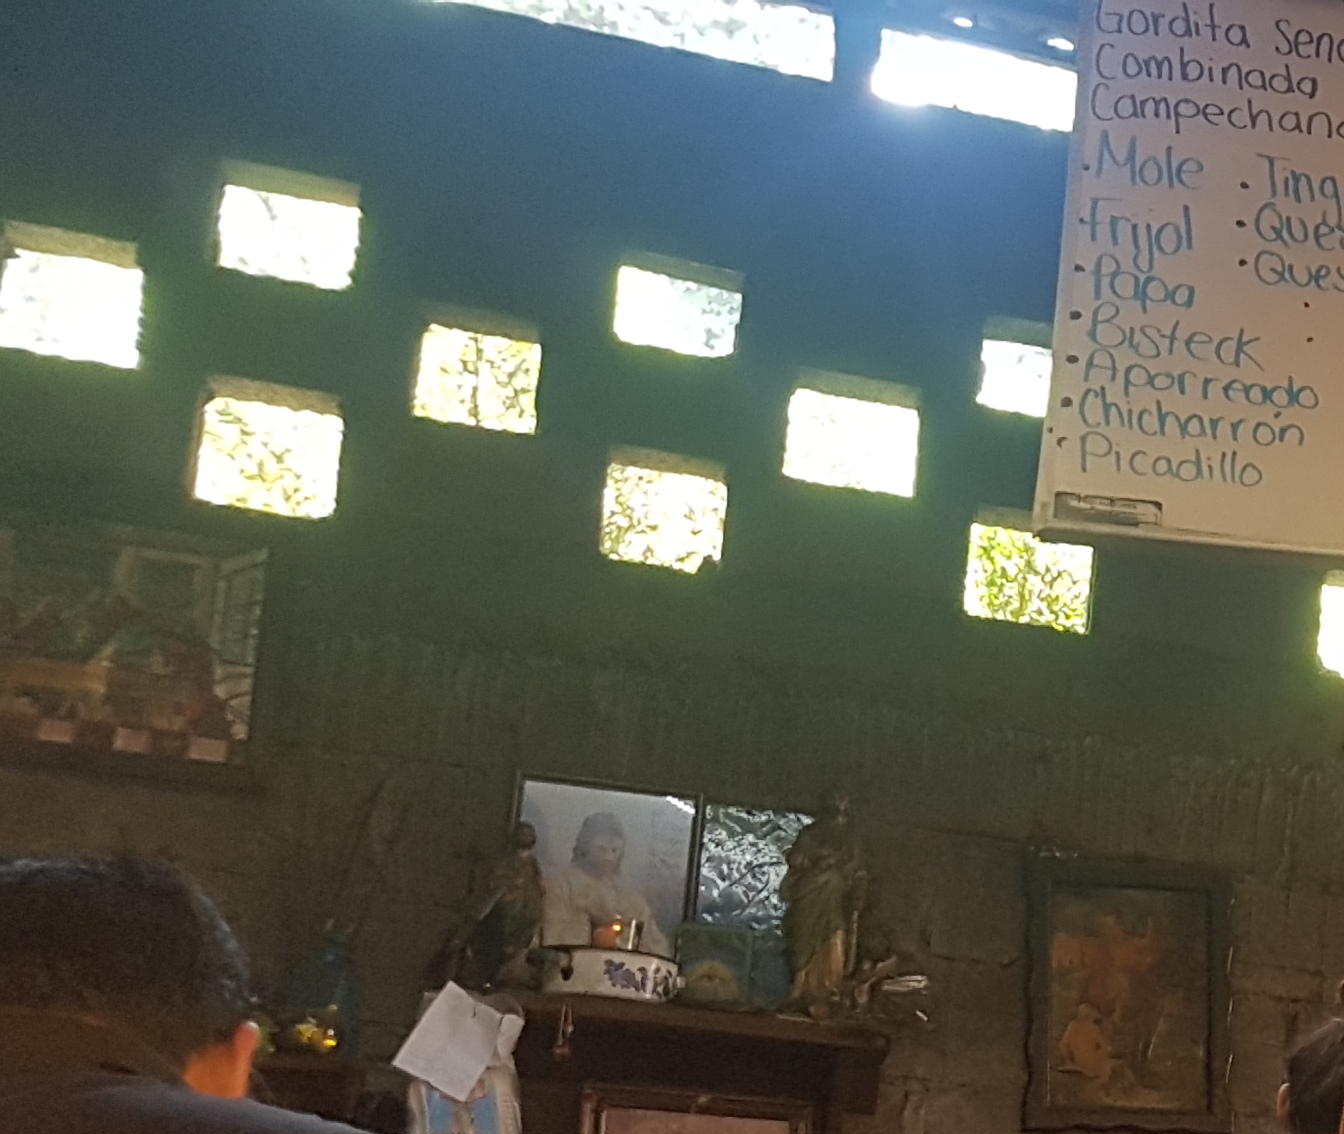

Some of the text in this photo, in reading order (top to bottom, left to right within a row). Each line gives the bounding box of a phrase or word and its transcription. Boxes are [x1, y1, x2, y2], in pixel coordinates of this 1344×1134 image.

[1096, 0, 1250, 48] Gordita
[1096, 43, 1319, 99] Combinada
[1095, 129, 1204, 190] Mole
[1092, 254, 1196, 315] Papa
[1087, 301, 1264, 371] Bisteck
[1084, 348, 1320, 410] Aporreado
[1078, 387, 1305, 447] Chicharrón
[1079, 431, 1263, 487] Picadillo
